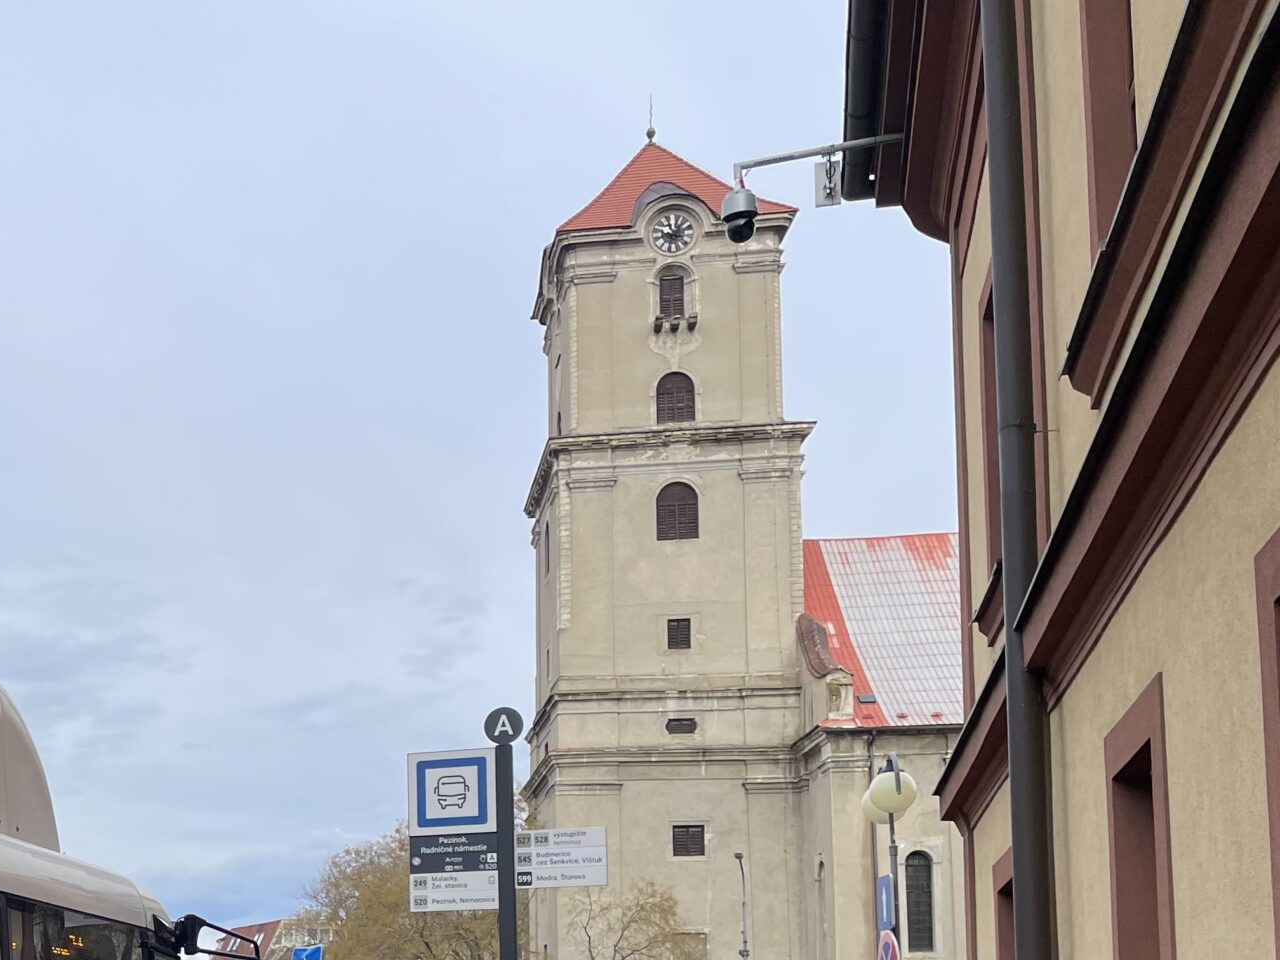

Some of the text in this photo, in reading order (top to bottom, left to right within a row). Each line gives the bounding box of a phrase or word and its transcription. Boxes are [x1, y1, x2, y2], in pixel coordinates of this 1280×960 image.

[494, 714, 514, 736] A
[516, 835, 549, 845] 527 528
[517, 855, 532, 863] 545
[517, 875, 532, 883] 599
[414, 898, 428, 906] 520
